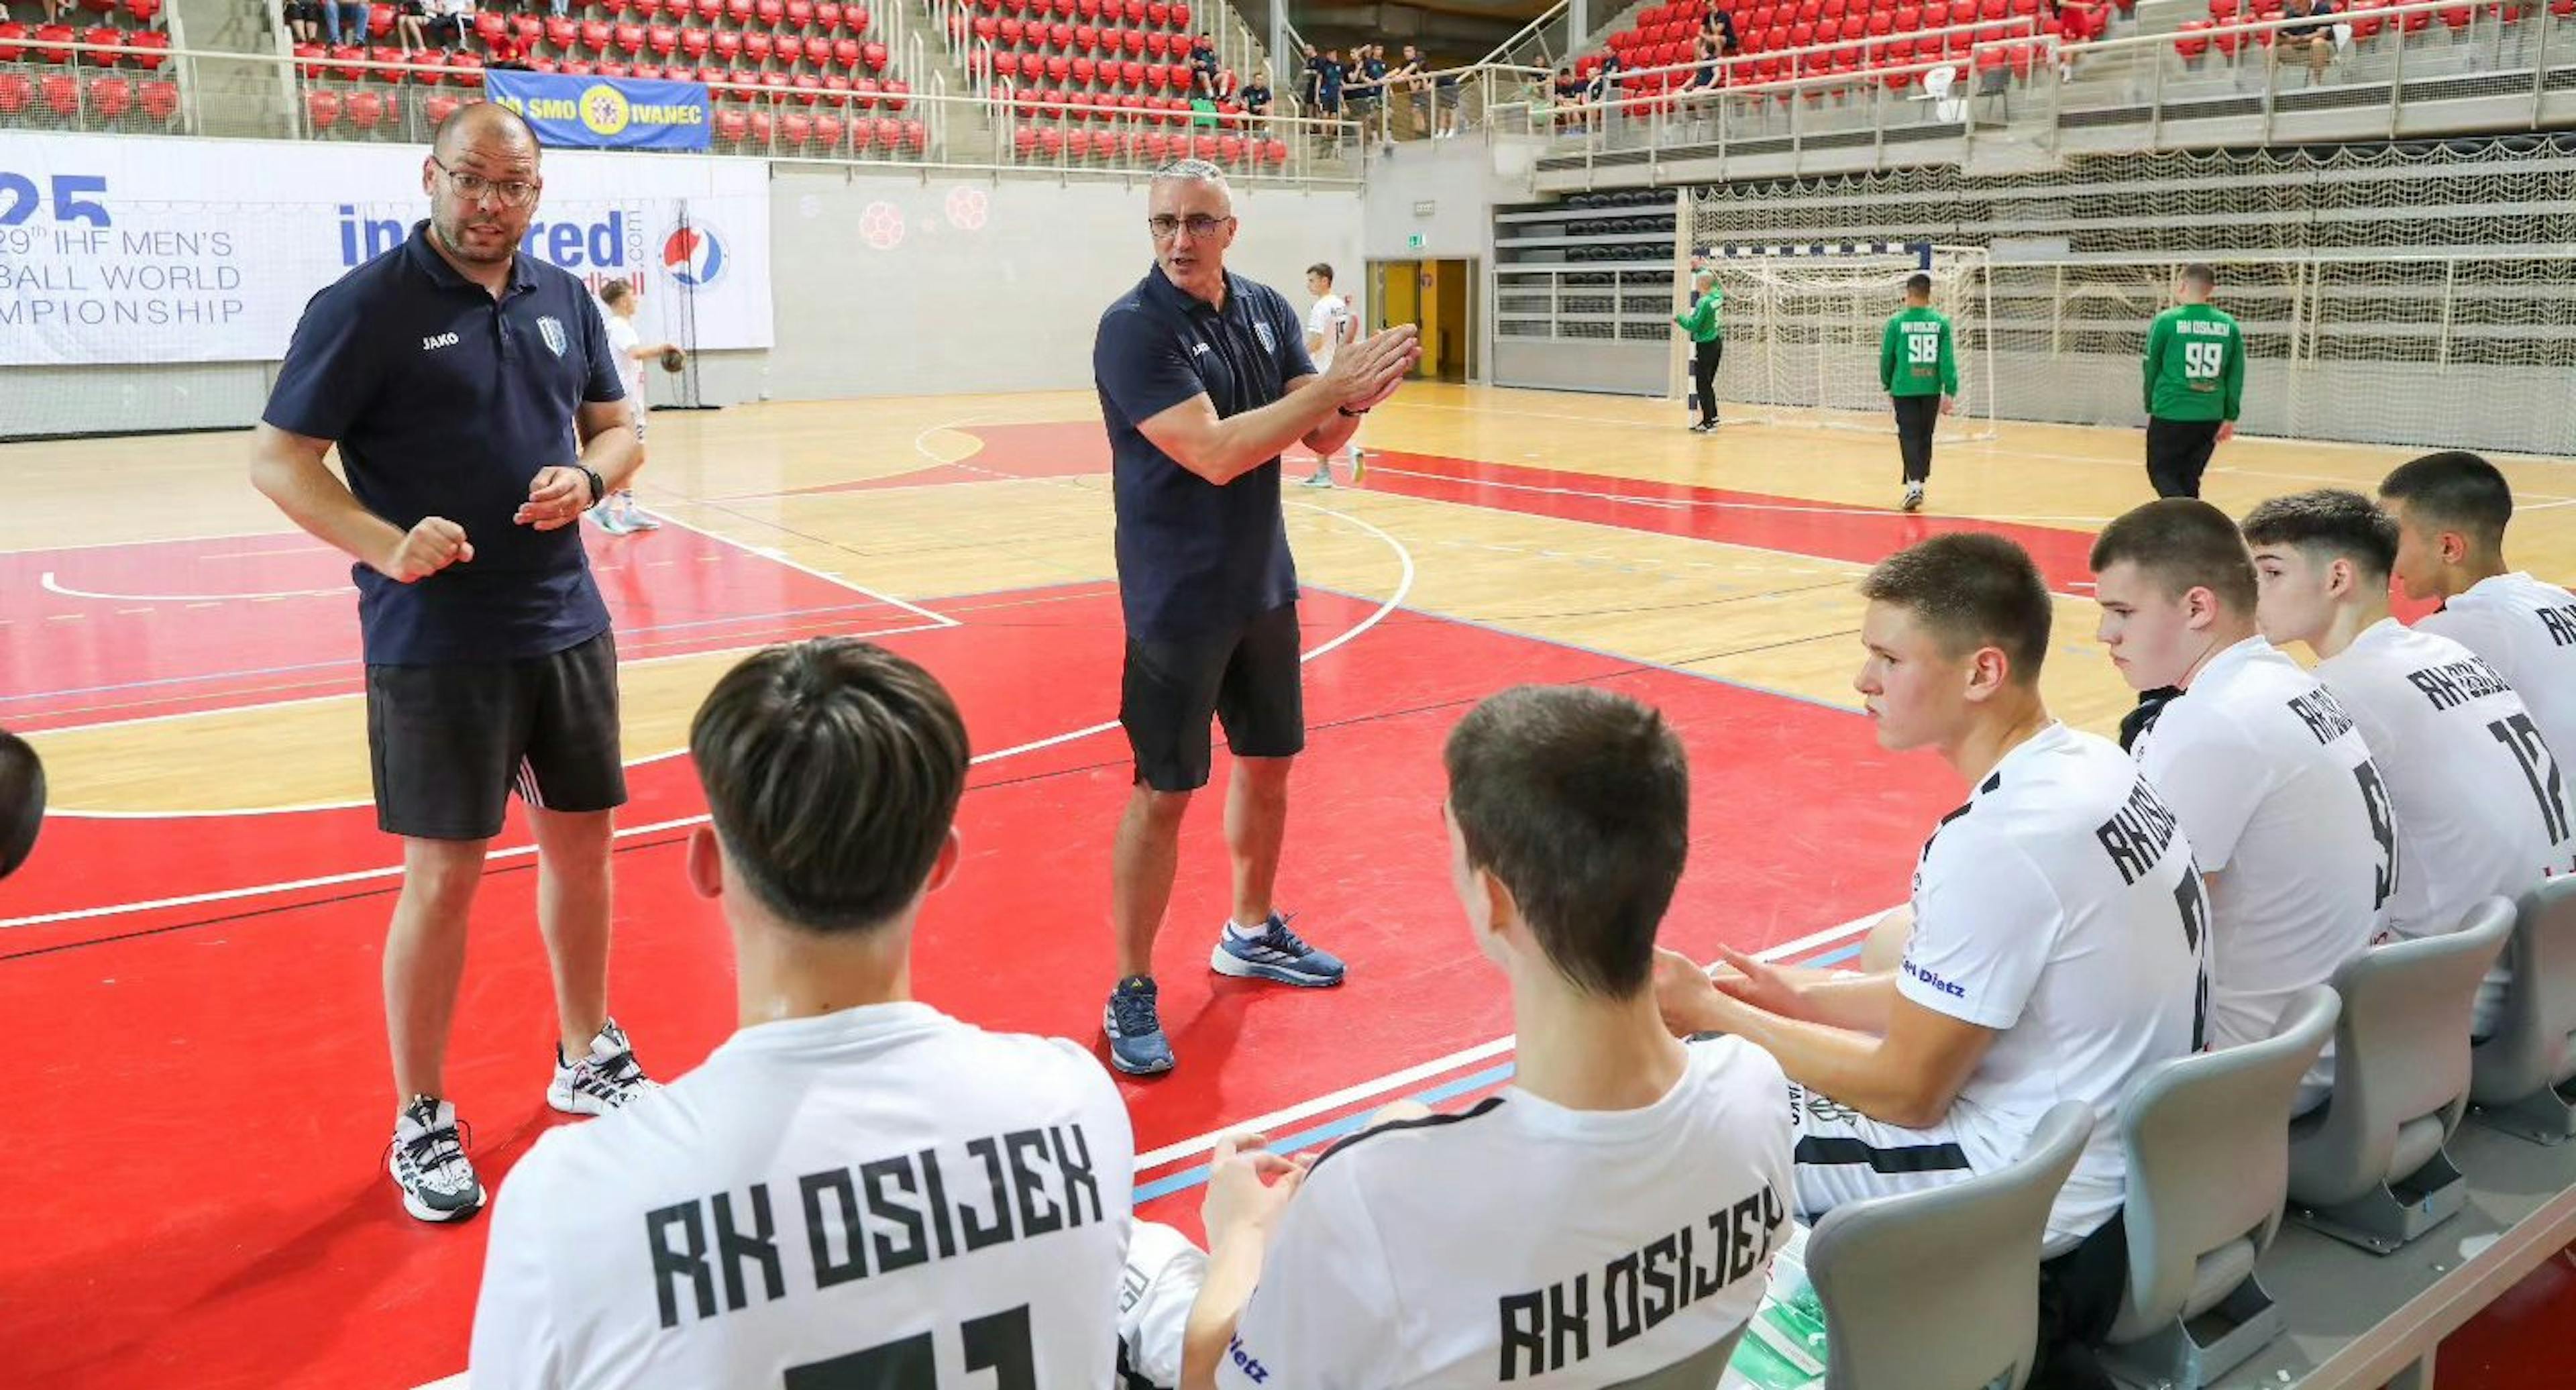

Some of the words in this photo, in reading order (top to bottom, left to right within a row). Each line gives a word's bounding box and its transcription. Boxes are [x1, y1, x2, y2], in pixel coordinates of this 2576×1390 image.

[529, 99, 577, 120] SMO
[632, 105, 702, 125] IVANEC
[54, 230, 109, 254] IHF
[123, 231, 232, 256] MEN'S
[100, 265, 240, 290] WORLD
[422, 331, 460, 352] JAKO
[1908, 333, 1939, 363] 98
[2185, 342, 2223, 378] 99
[2406, 667, 2469, 711] RK
[2096, 806, 2161, 886] RK
[644, 1183, 786, 1330] RK
[799, 1123, 1103, 1291] OSIJEK
[1499, 1272, 1589, 1382] RK
[1230, 1332, 1269, 1385] ietz
